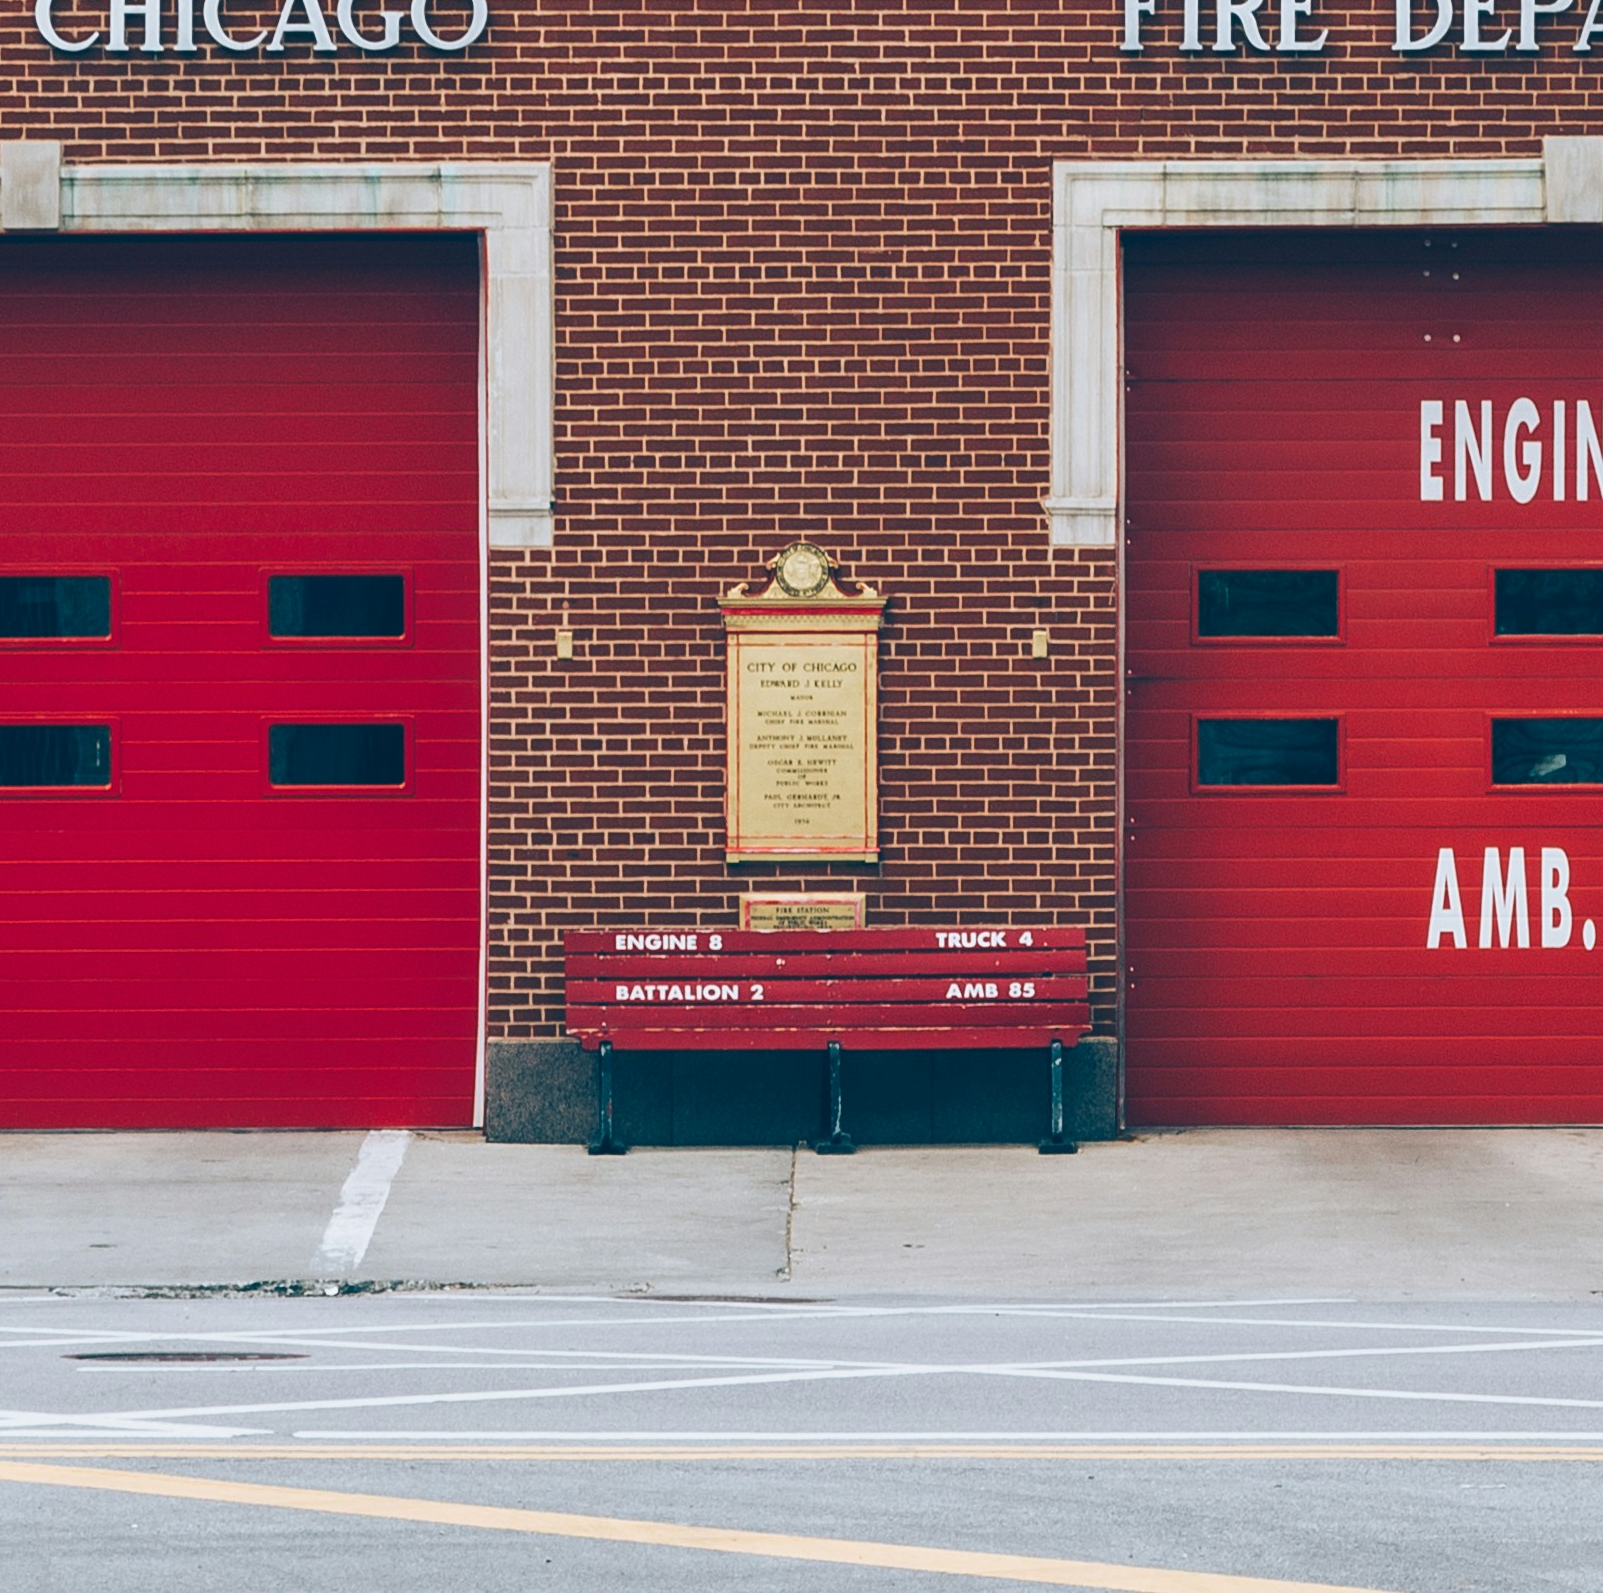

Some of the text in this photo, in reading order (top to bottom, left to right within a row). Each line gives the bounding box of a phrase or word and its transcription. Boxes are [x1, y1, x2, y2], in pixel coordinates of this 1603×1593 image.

[746, 661, 858, 673] CITY OF CHICAGO
[1426, 846, 1596, 951] AMB.
[775, 906, 830, 914] FIRE STATION
[615, 934, 723, 951] ENGINE 8
[935, 931, 1034, 948] TRUCK 4
[615, 984, 764, 1001] BATTALION 2
[945, 982, 1036, 999] AMB 85
